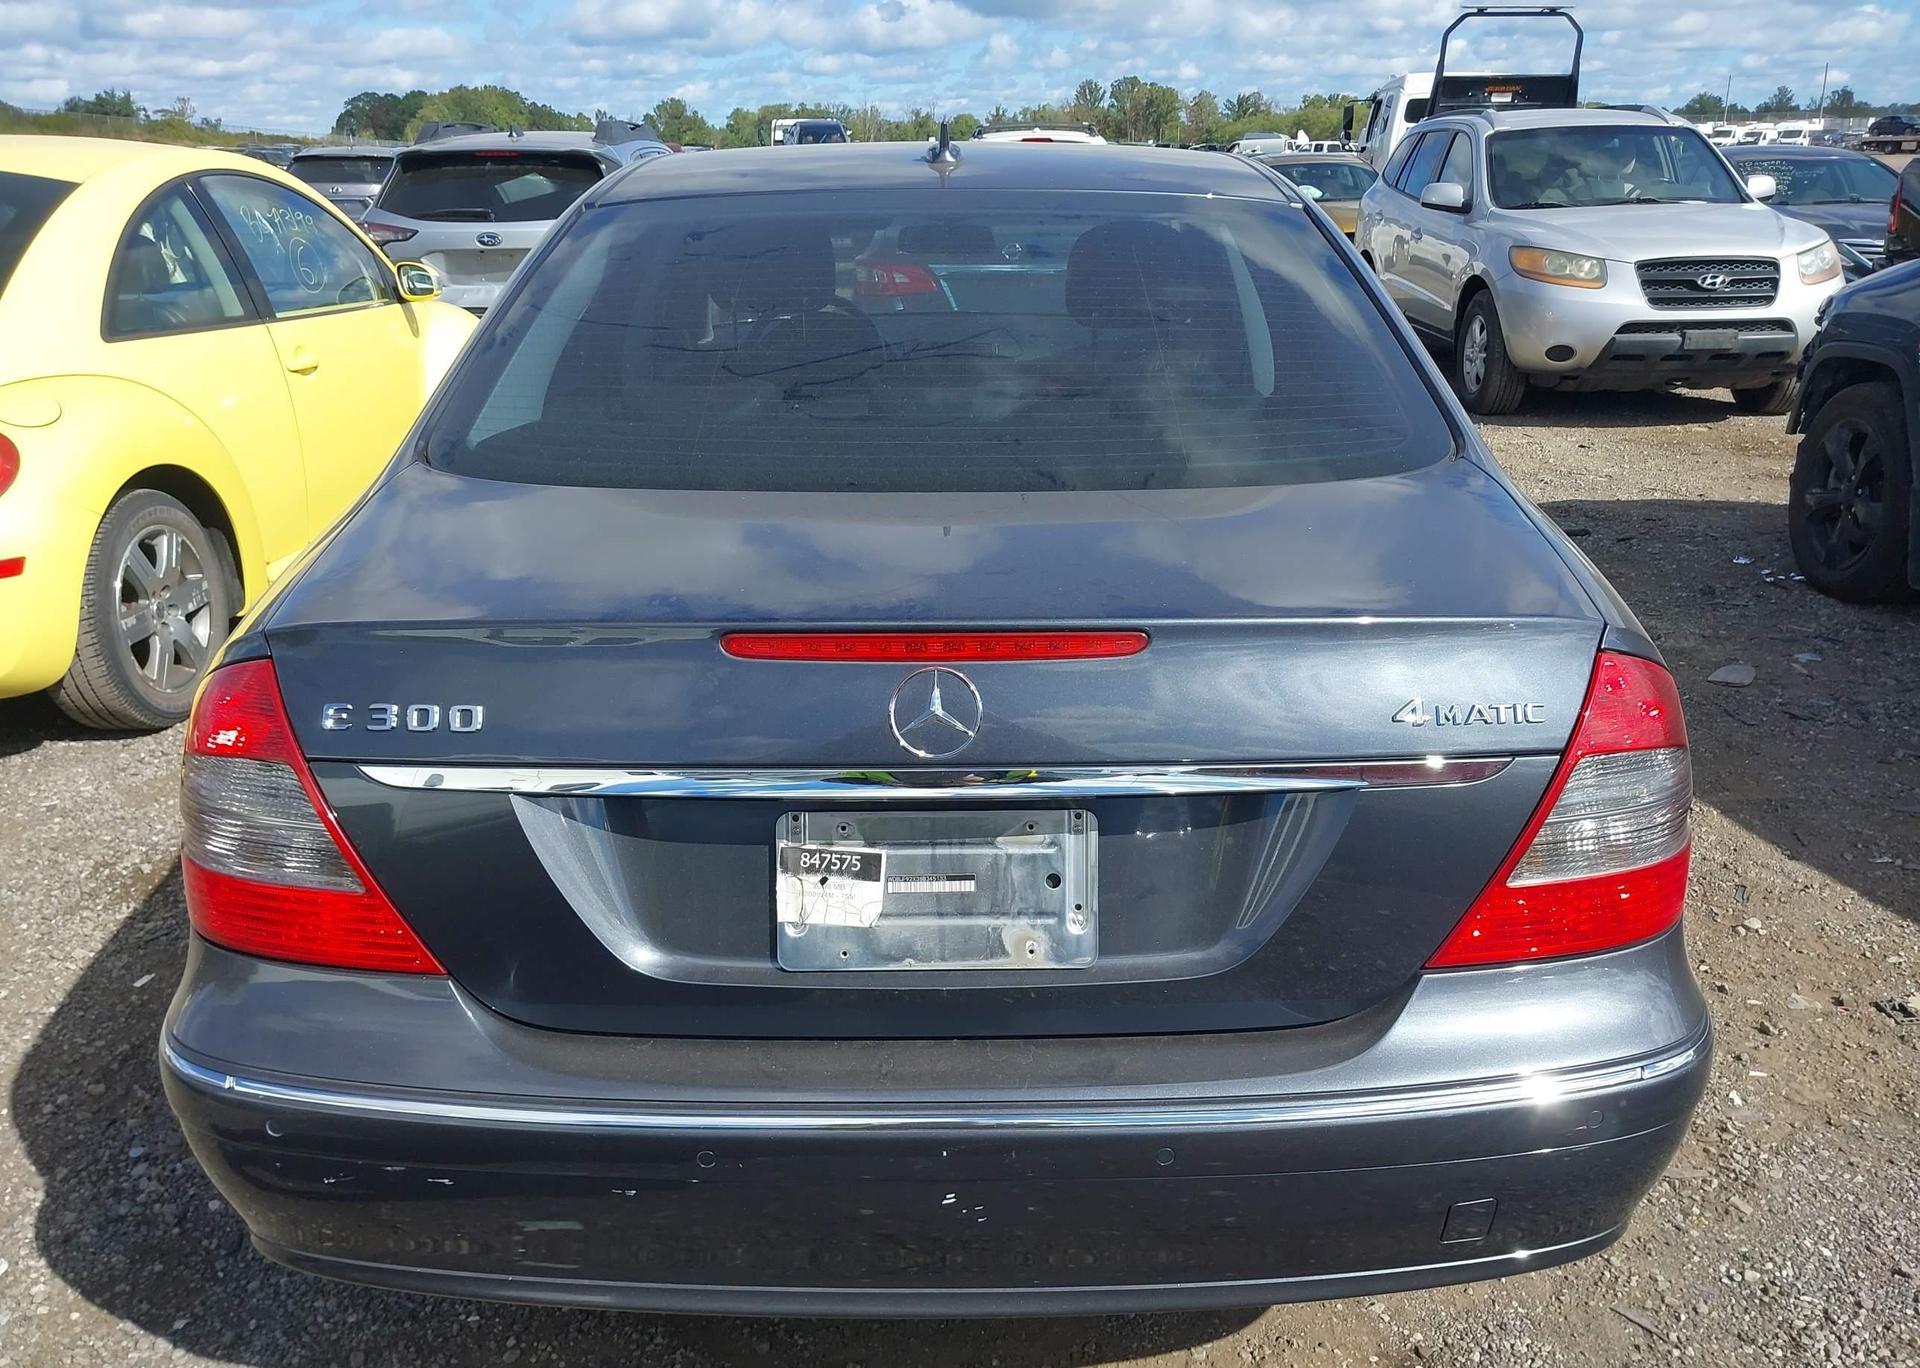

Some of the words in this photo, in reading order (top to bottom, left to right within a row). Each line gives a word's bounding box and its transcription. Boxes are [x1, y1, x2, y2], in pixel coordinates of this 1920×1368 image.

[322, 703, 353, 730] E
[366, 703, 484, 732] 300
[800, 852, 861, 871] 847575
